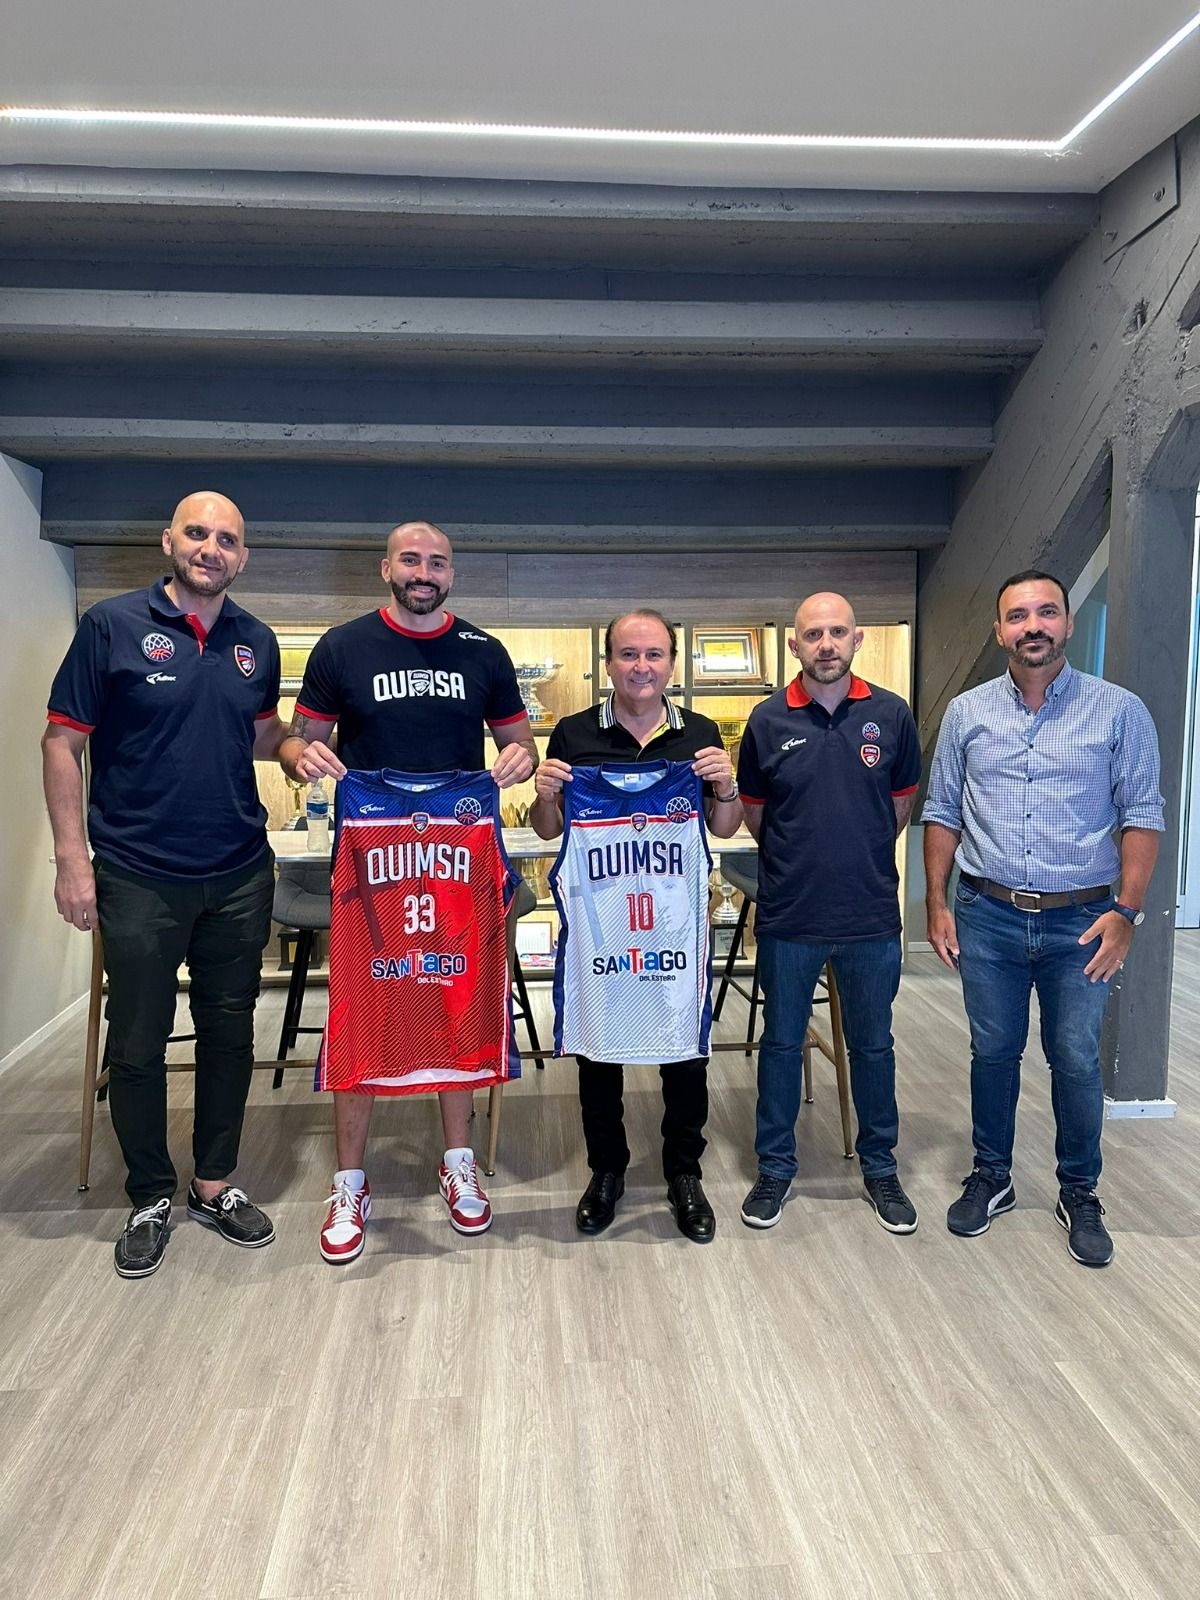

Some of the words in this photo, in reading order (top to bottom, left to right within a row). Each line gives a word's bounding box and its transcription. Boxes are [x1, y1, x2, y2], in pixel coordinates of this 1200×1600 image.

[366, 841, 471, 885] QUIMSA
[587, 840, 684, 882] QUIMSA
[403, 893, 436, 935] 33
[626, 892, 655, 932] 10
